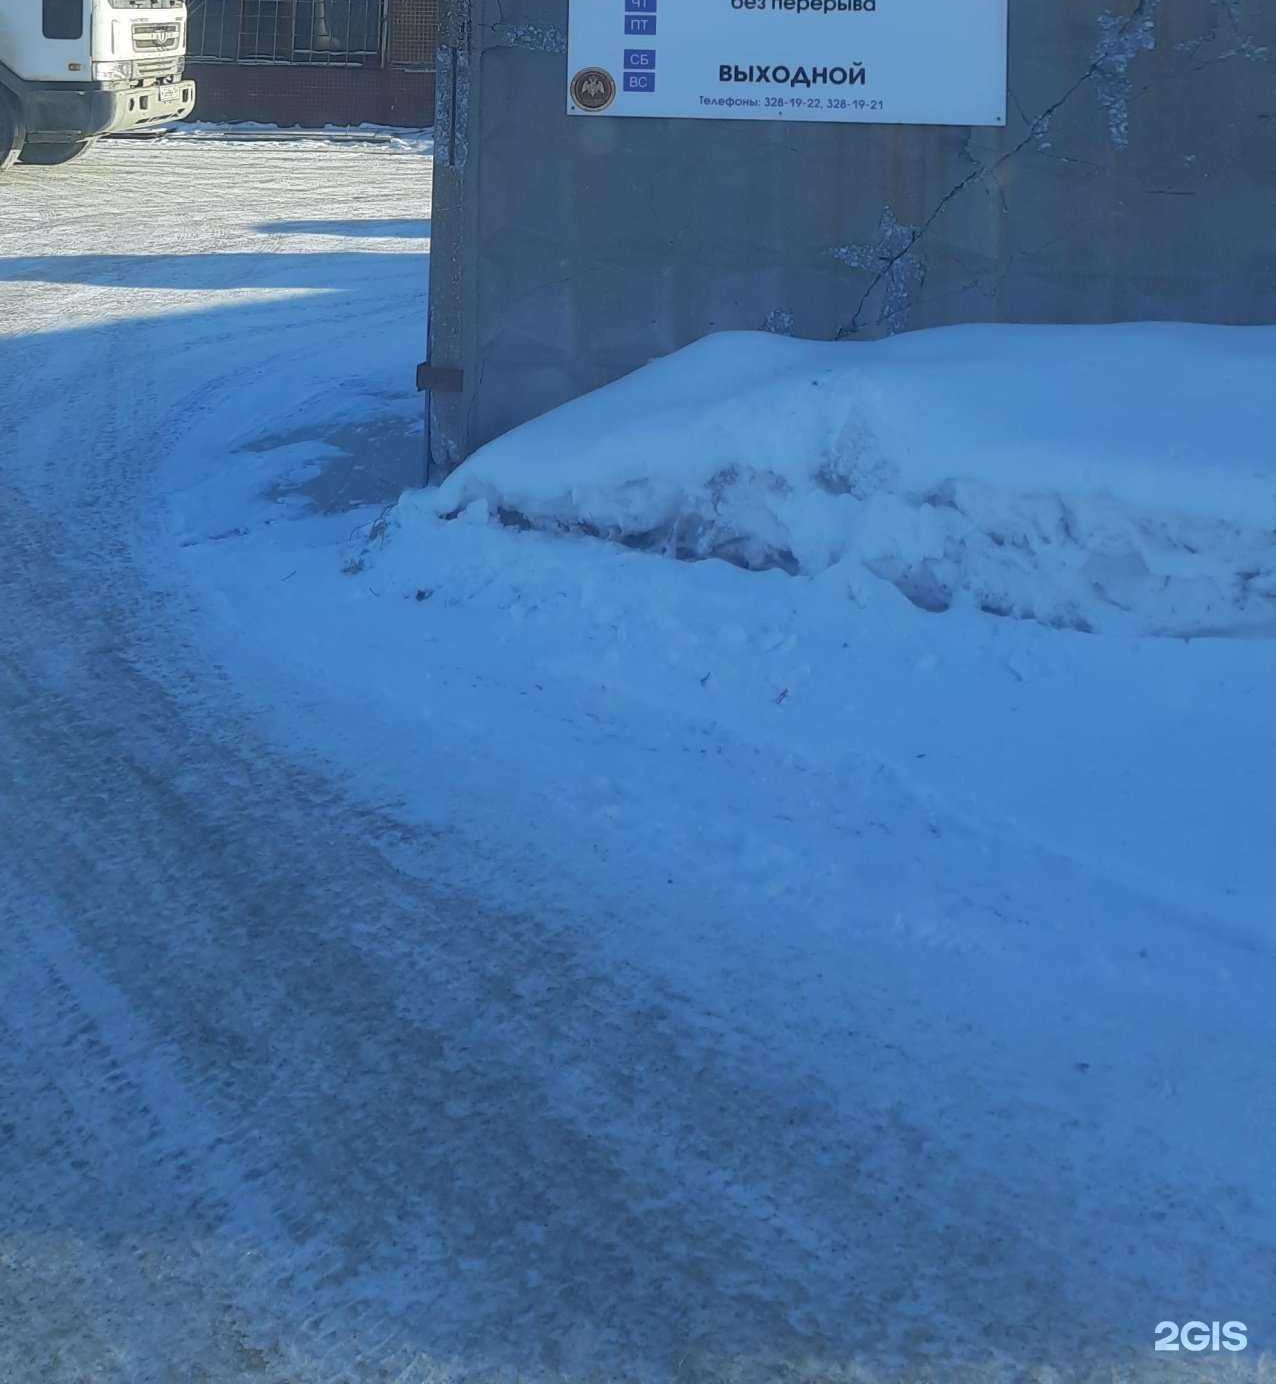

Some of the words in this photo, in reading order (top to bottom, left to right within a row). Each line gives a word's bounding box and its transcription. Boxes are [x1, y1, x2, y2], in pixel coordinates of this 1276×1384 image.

[630, 18, 649, 32] ПТ
[629, 53, 649, 66] СБ
[629, 75, 648, 89] ВС
[698, 95, 761, 107] Телефоны:
[764, 96, 824, 109] 328-19-22,
[827, 98, 883, 110] 328-19-21
